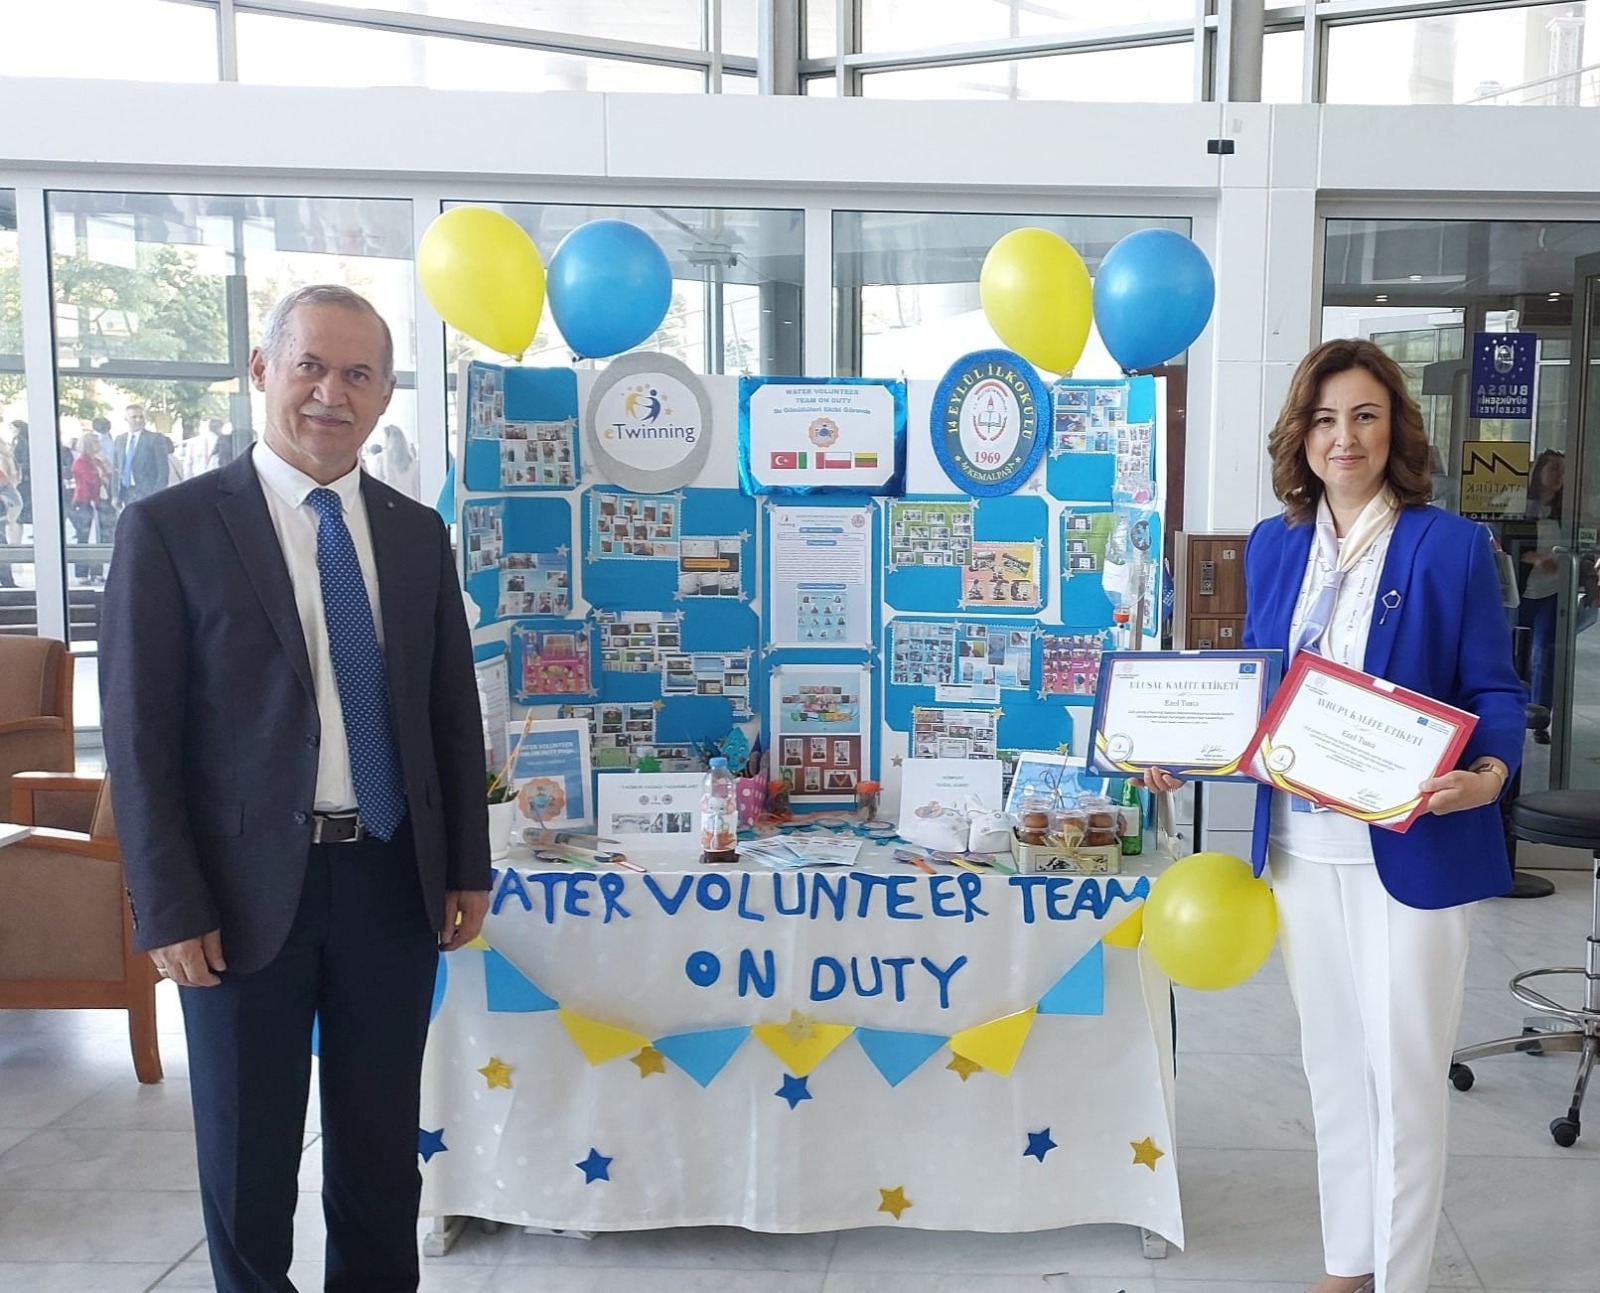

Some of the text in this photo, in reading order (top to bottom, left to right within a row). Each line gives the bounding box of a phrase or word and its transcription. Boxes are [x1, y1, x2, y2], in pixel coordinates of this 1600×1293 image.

[948, 369, 985, 416] EYLÜL
[988, 363, 1035, 440] İLKOKULU
[604, 423, 696, 443] eTwinning
[946, 421, 959, 434] 14
[975, 451, 1001, 464] 1969
[1226, 551, 1232, 559] 1
[1166, 680, 1200, 690] KALİTE
[1201, 680, 1239, 690] ETİKETİ
[492, 867, 1151, 924] ATER VOLUNTEER TEAM
[685, 948, 968, 1009] ON DUTY
